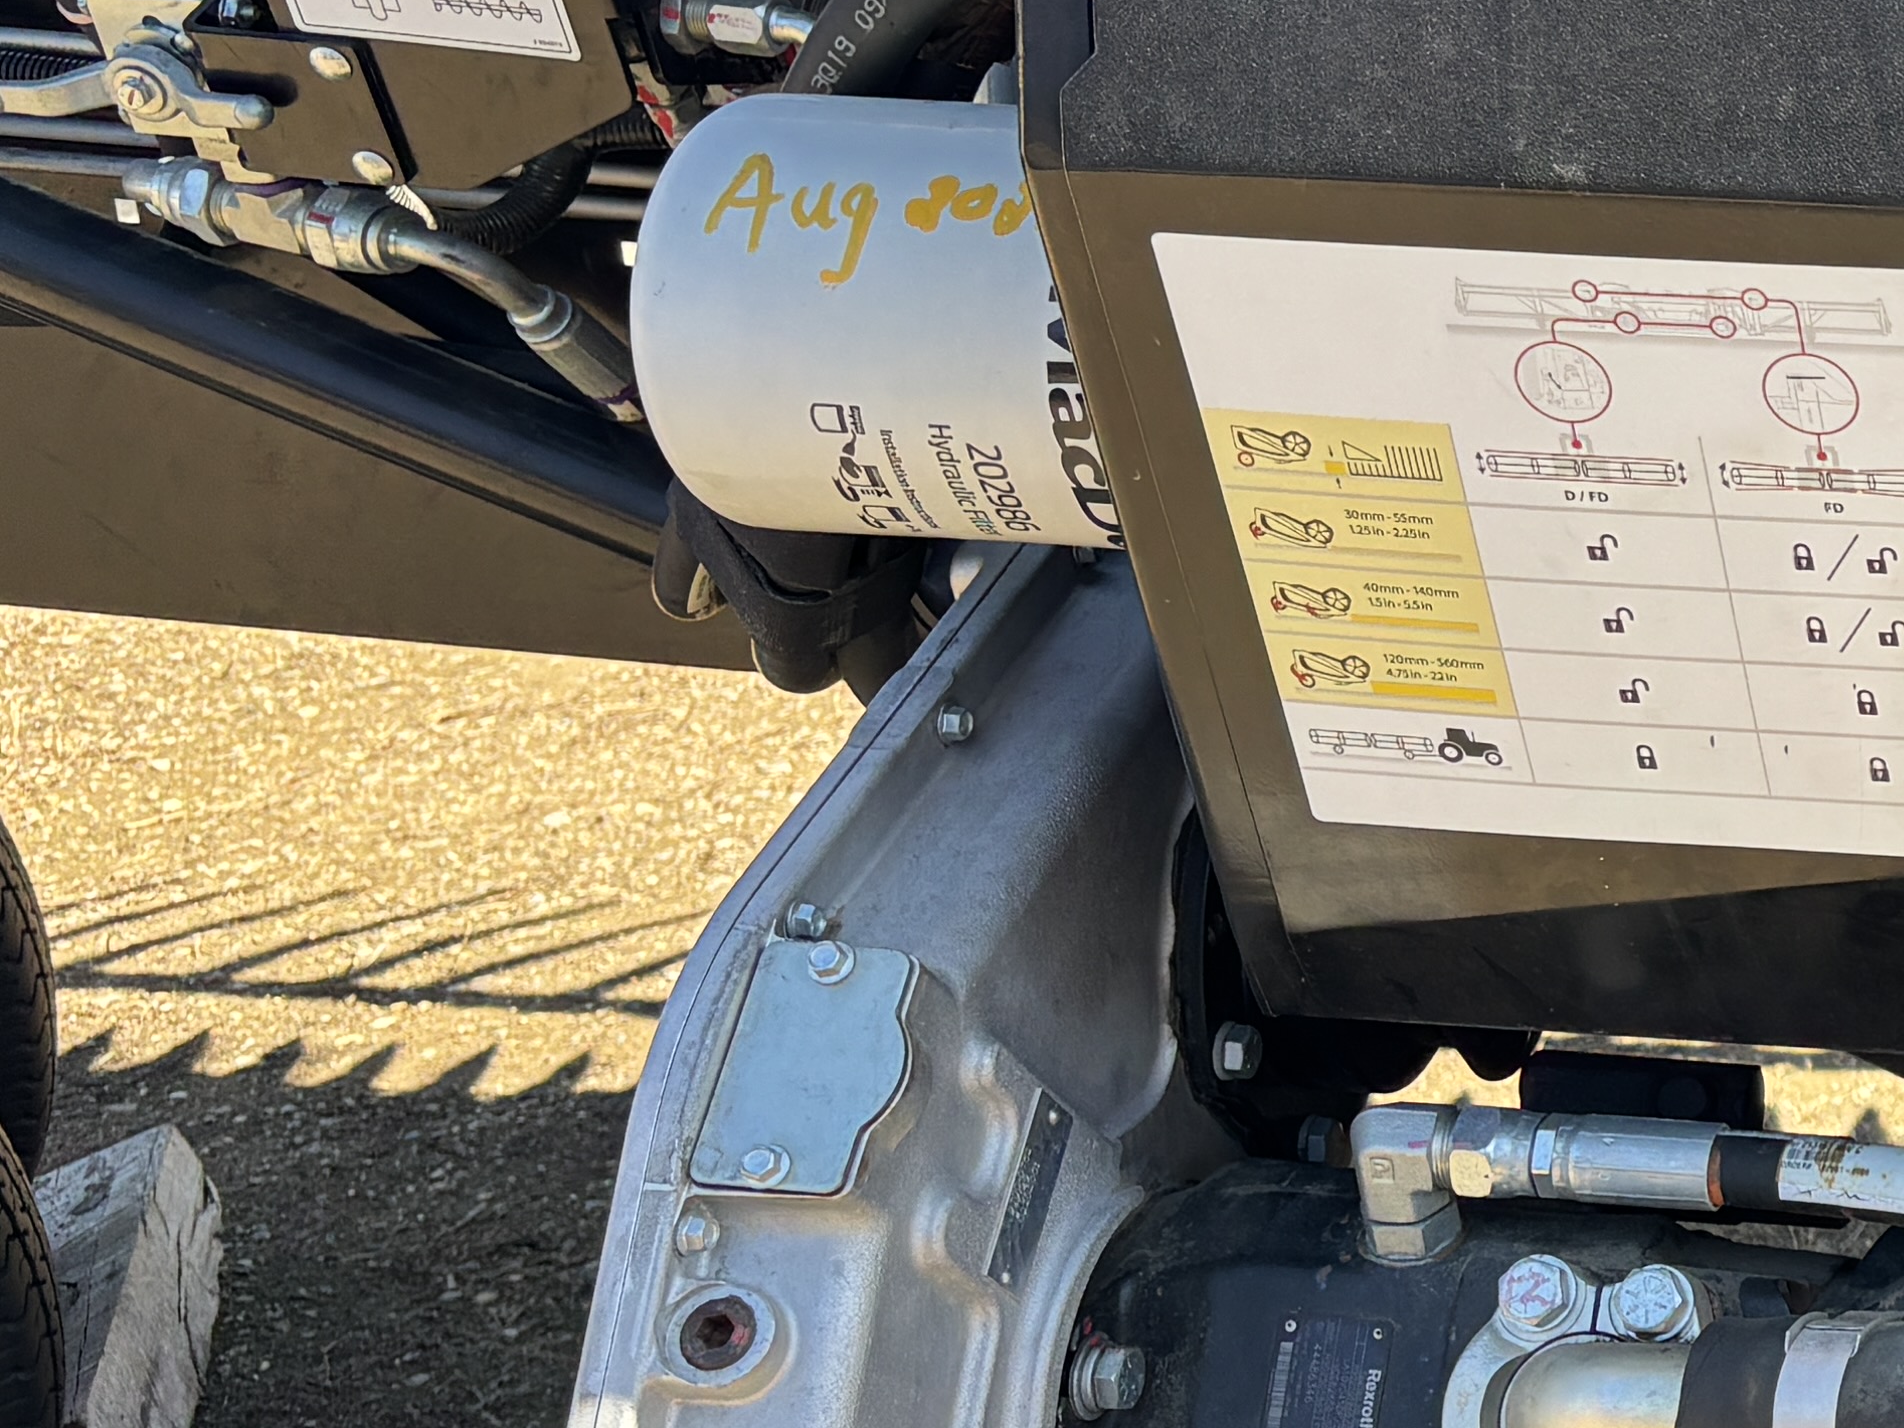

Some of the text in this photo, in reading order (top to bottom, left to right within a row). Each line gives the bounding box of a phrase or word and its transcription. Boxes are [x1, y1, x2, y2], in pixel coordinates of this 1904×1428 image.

[704, 152, 879, 290] Aug
[928, 423, 977, 508] Hydraulic
[965, 442, 1042, 533] 202986
[1824, 502, 1845, 514] FD
